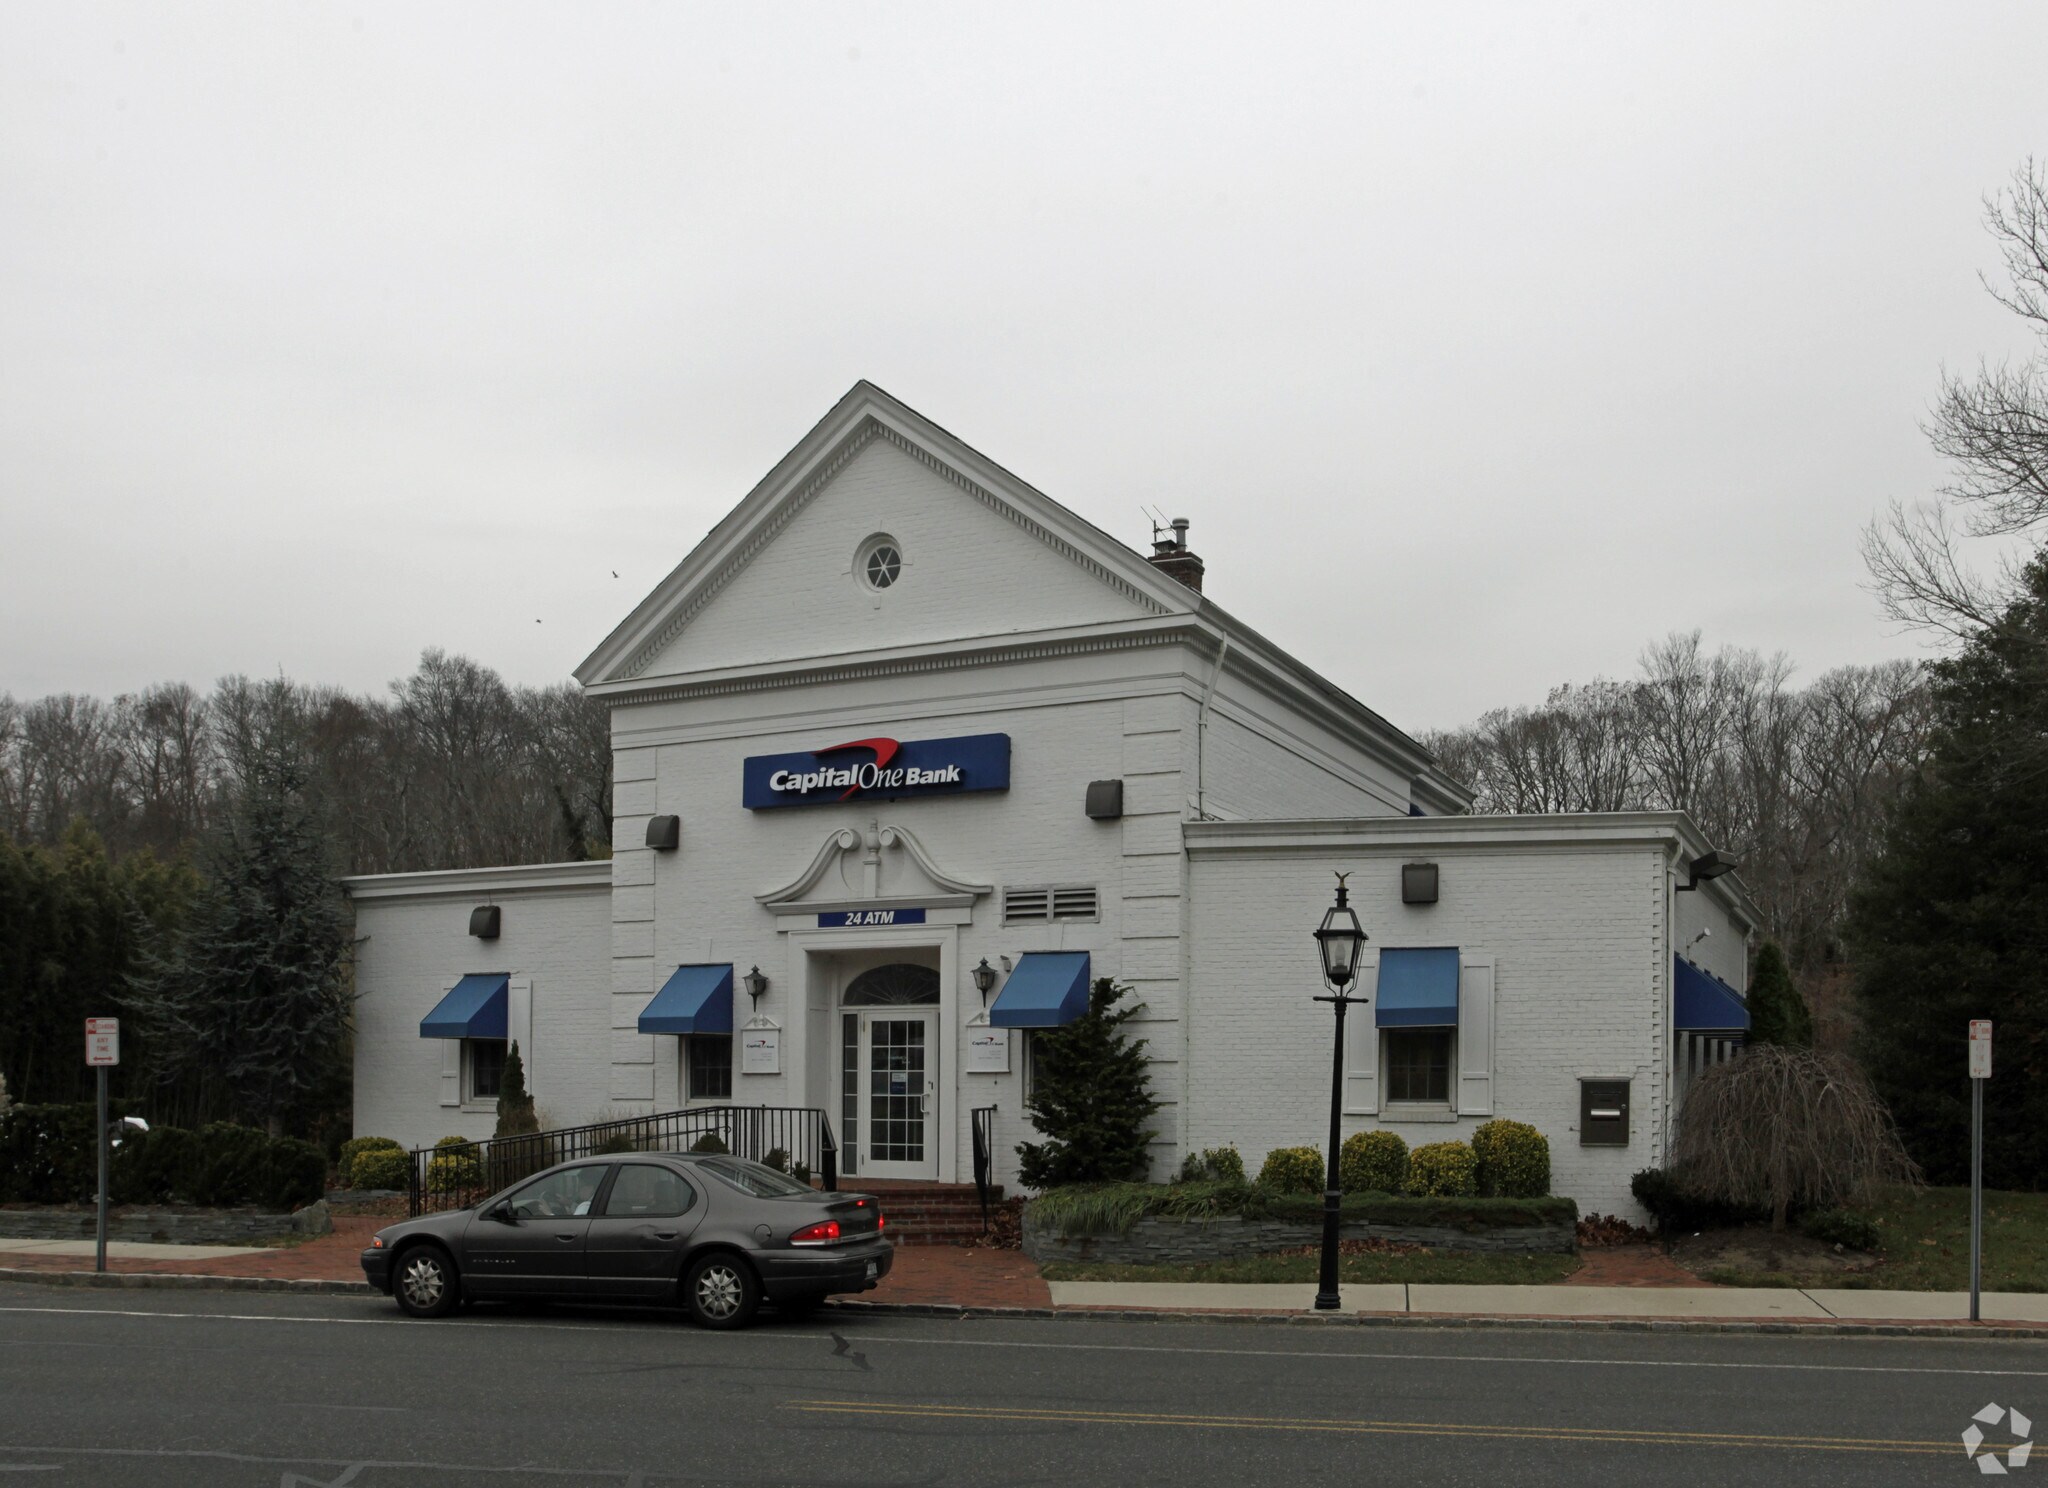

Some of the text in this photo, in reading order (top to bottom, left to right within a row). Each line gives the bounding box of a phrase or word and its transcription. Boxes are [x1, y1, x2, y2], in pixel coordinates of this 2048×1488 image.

[905, 764, 960, 786] Bank
[845, 911, 895, 925] 24 ATM
